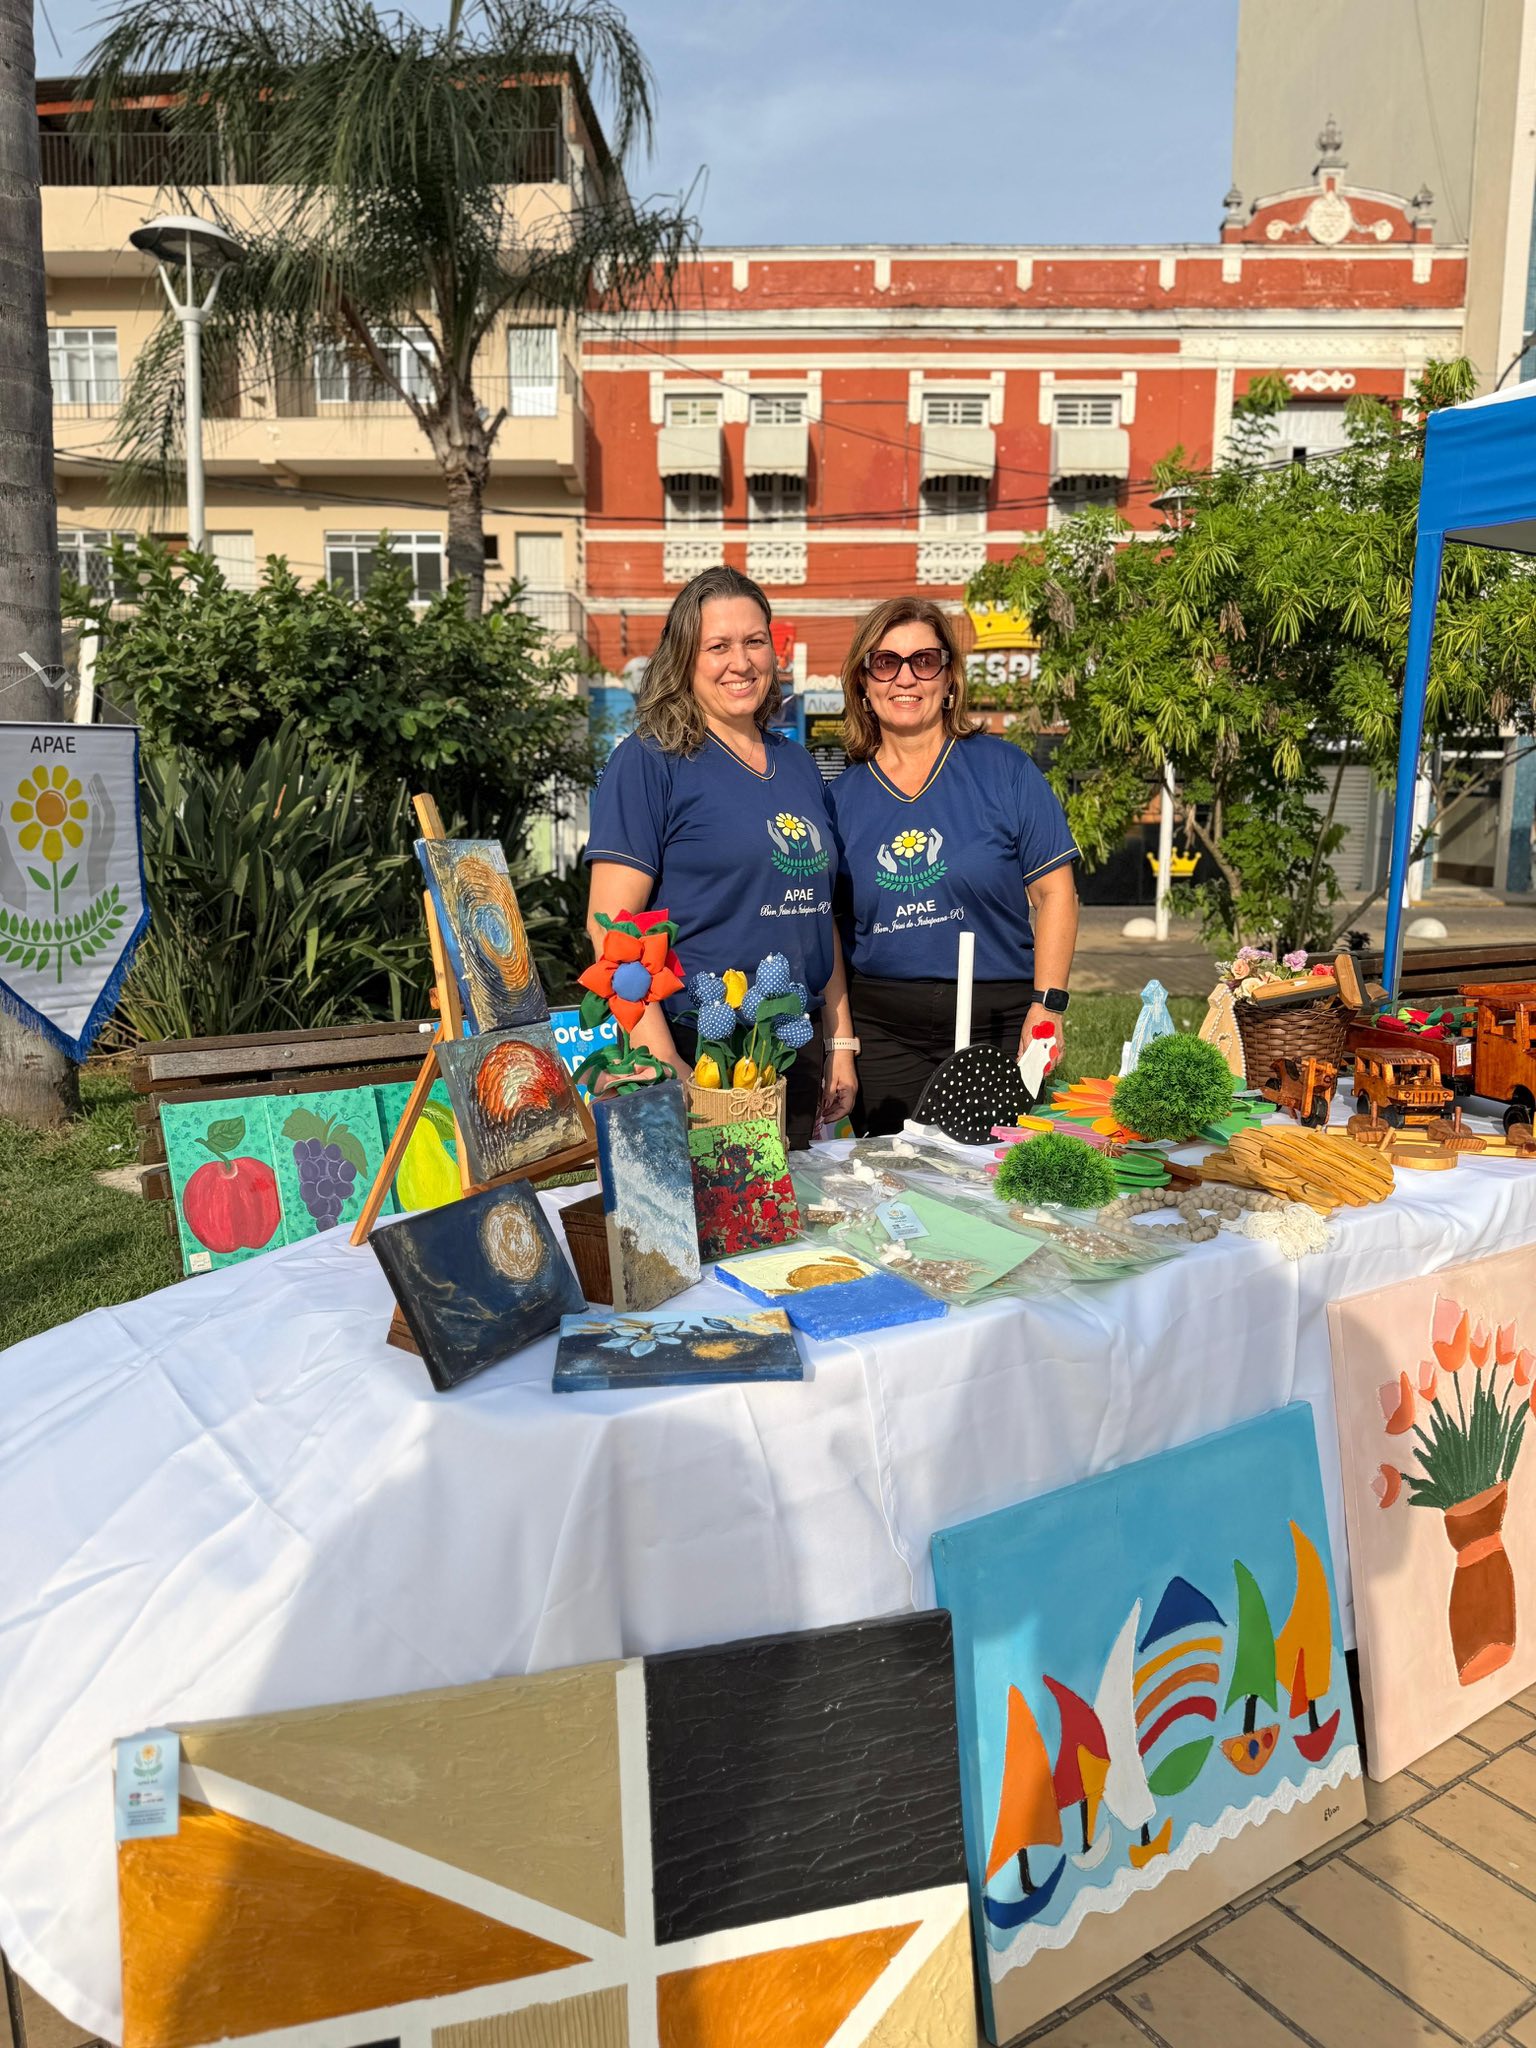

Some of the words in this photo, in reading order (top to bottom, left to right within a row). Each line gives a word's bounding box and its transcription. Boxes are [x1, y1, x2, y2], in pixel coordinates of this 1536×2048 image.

[30, 735, 77, 754] APAE
[784, 888, 815, 902] APAE
[760, 904, 777, 917] Bom
[896, 900, 937, 917] APAE
[873, 922, 889, 934] Bom
